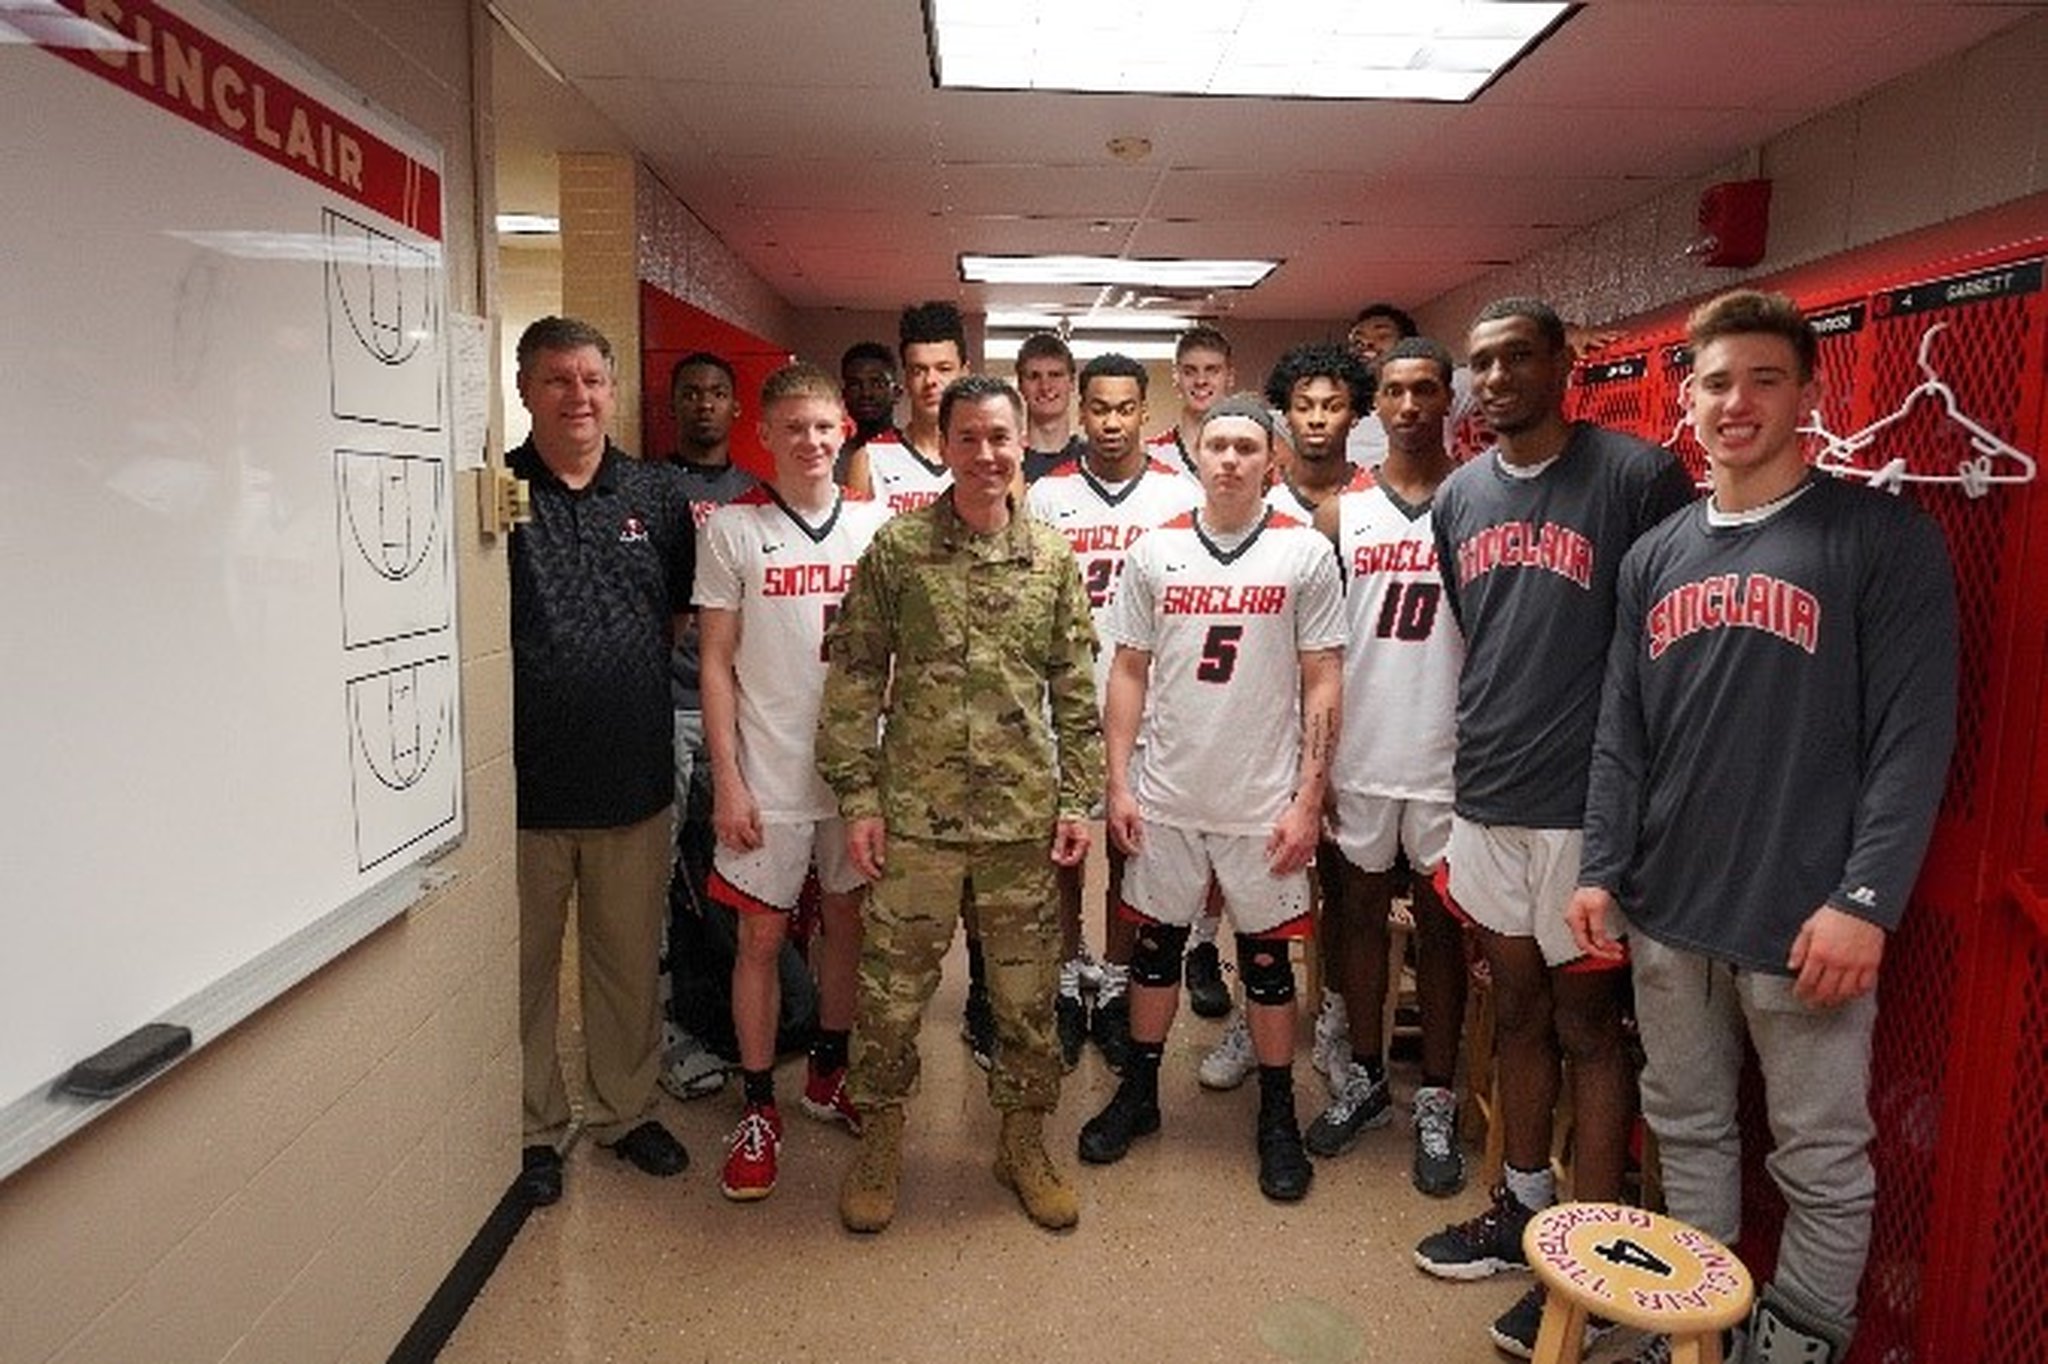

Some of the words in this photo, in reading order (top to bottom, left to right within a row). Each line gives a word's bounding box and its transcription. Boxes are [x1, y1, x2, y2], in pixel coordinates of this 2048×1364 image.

[83, 0, 364, 192] SINCLAIR
[1458, 521, 1593, 590] SINCLAIR
[1163, 585, 1286, 615] SINCLAIR
[1376, 582, 1442, 641] 10
[1648, 573, 1820, 660] SINCLAIR
[1196, 625, 1244, 684] 5
[1592, 1237, 1673, 1278] 4
